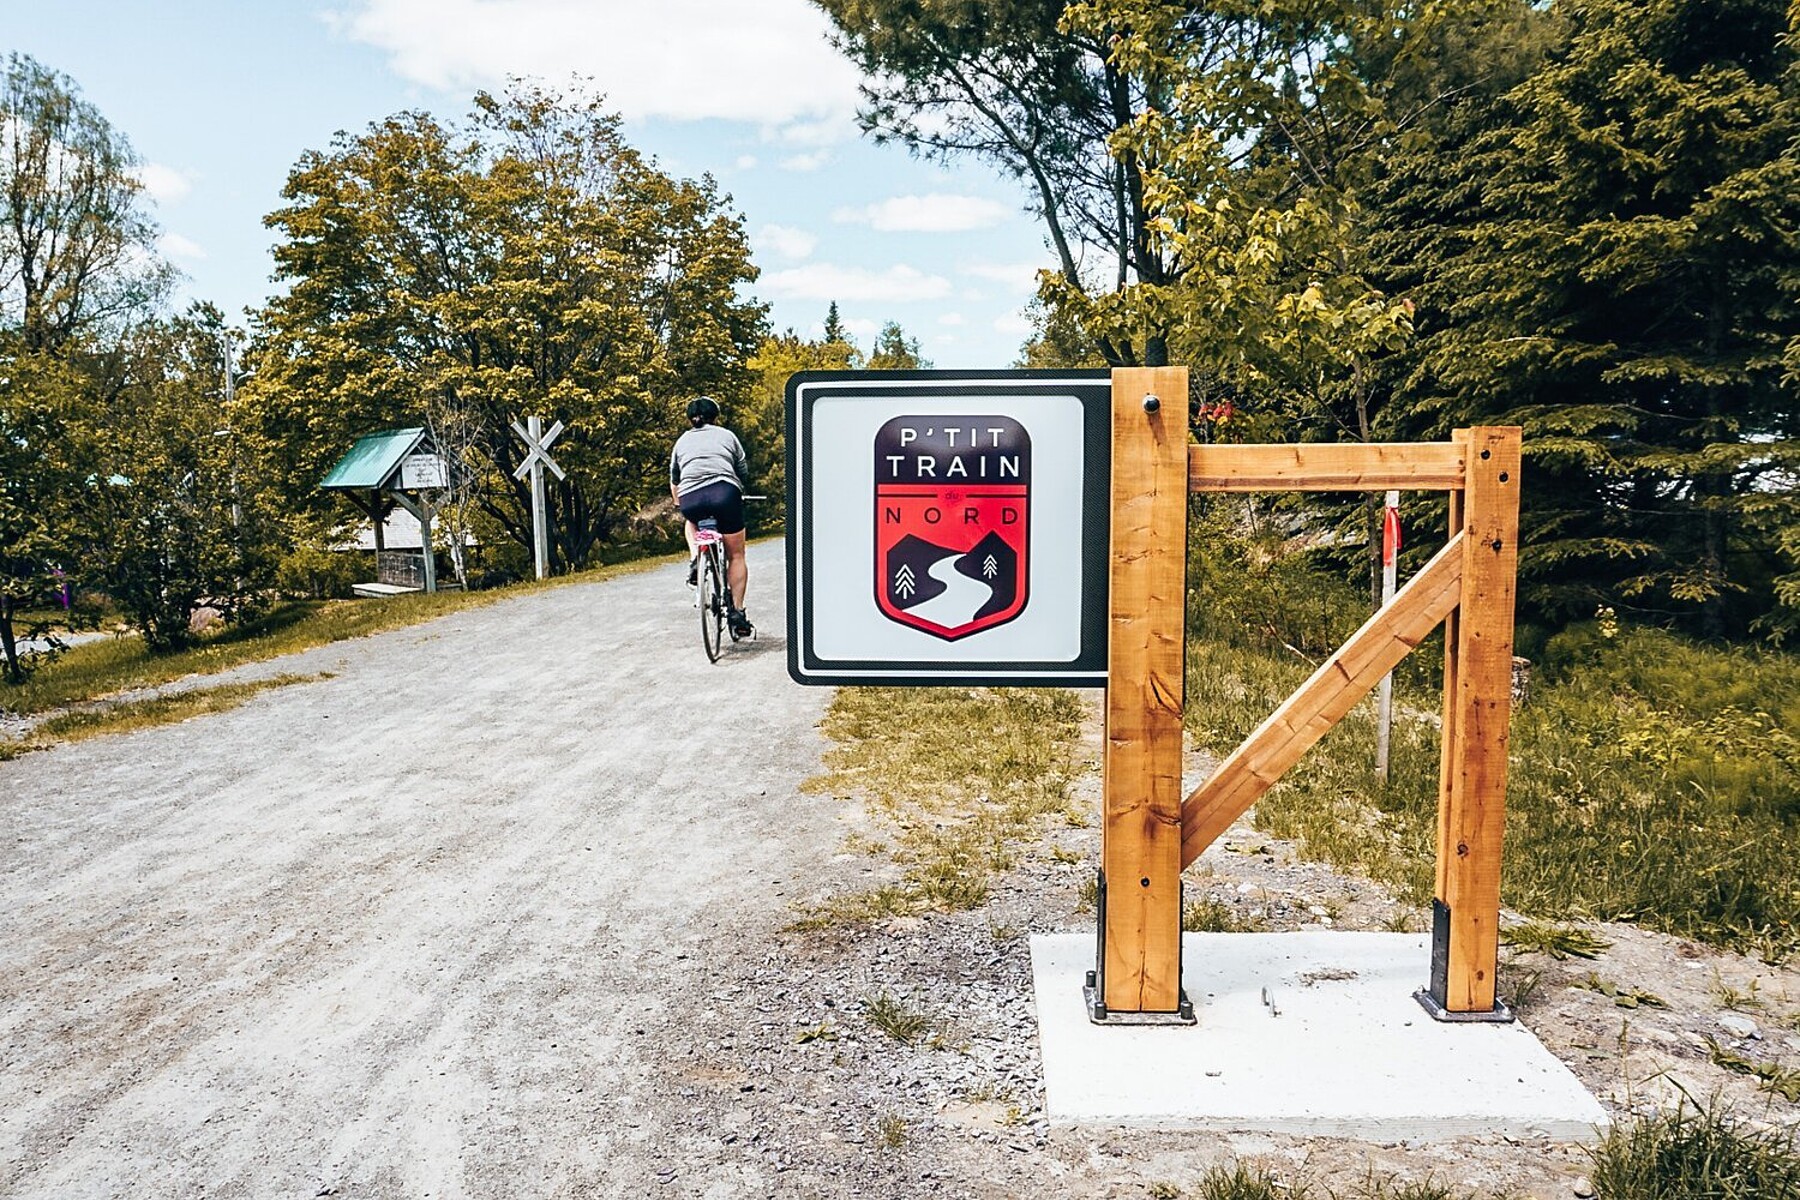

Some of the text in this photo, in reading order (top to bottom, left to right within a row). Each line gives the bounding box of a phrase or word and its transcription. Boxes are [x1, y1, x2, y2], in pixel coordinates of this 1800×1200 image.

[901, 428, 1004, 447] P'TIT
[886, 456, 1019, 477] TRAIN
[886, 507, 1018, 524] NORD
